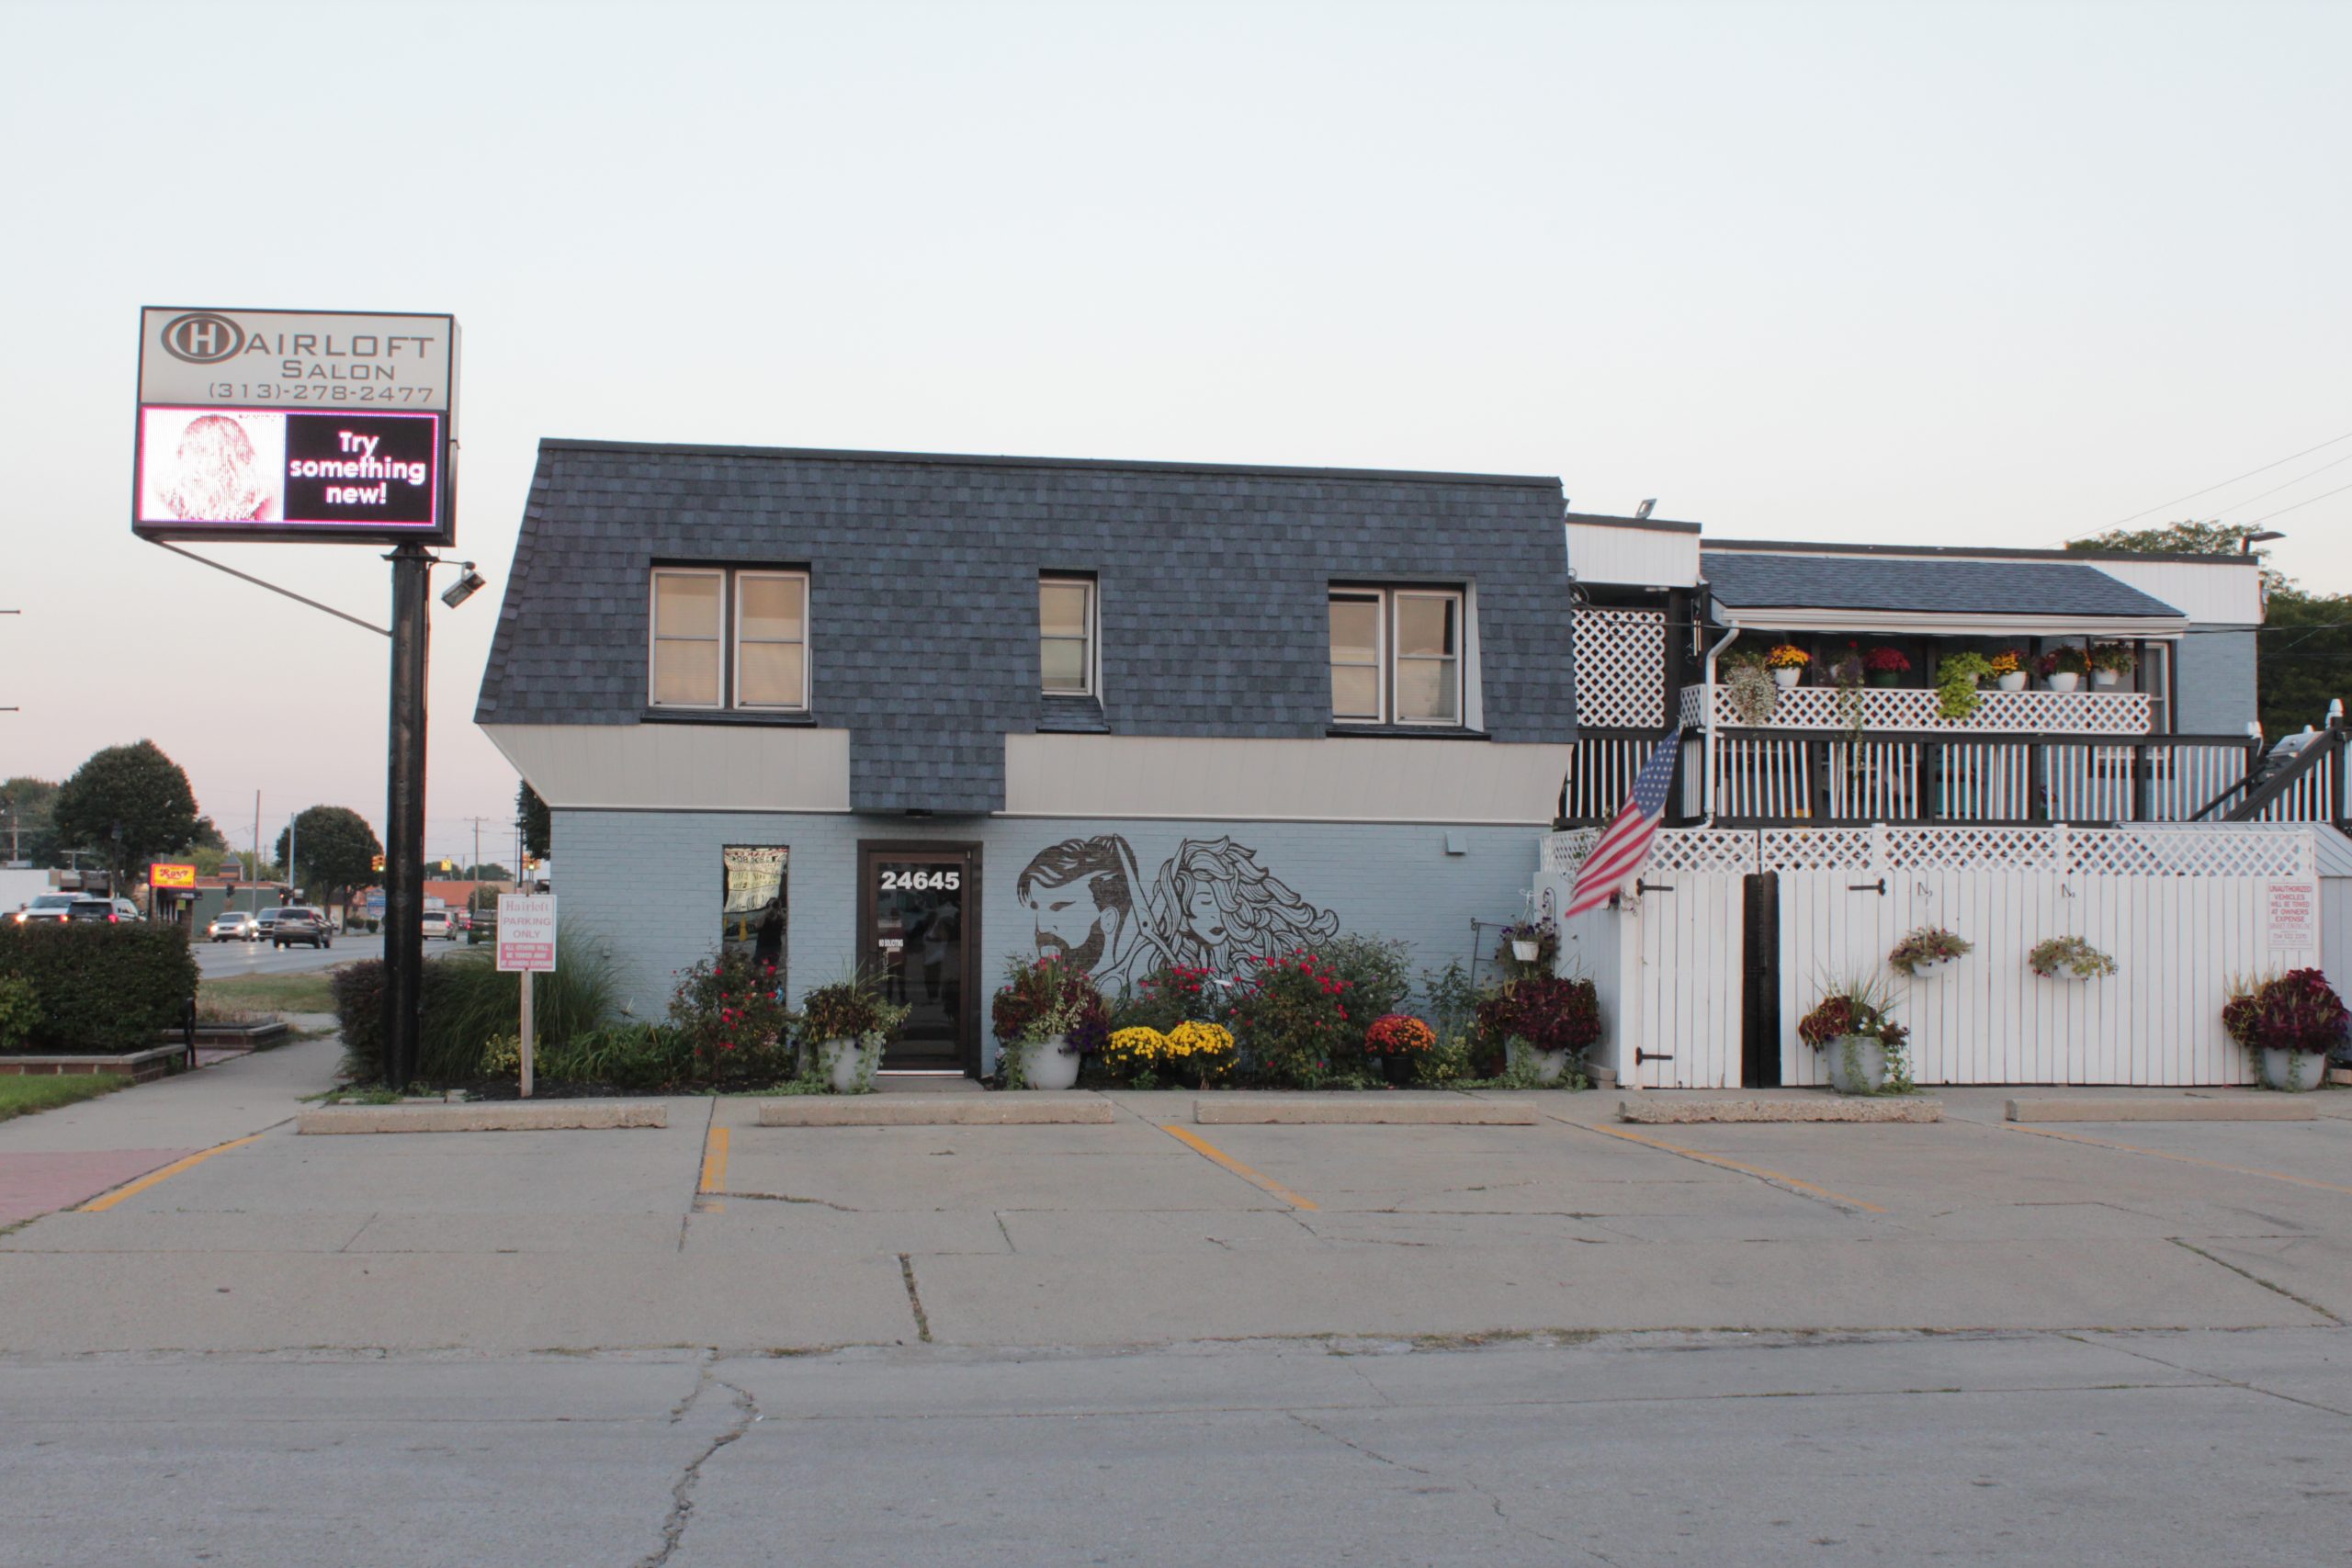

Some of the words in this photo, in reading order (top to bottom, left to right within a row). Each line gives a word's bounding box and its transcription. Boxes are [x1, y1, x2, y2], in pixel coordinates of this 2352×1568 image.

[175, 317, 435, 361] HAIRLOFT
[281, 359, 395, 380] SALON
[209, 382, 434, 403] (313)-278-2477
[339, 431, 379, 457] Try
[289, 456, 426, 485] something
[325, 482, 387, 504] new!
[881, 871, 960, 890] 24645
[503, 918, 551, 926] PARKING
[513, 930, 540, 938] ONLY
